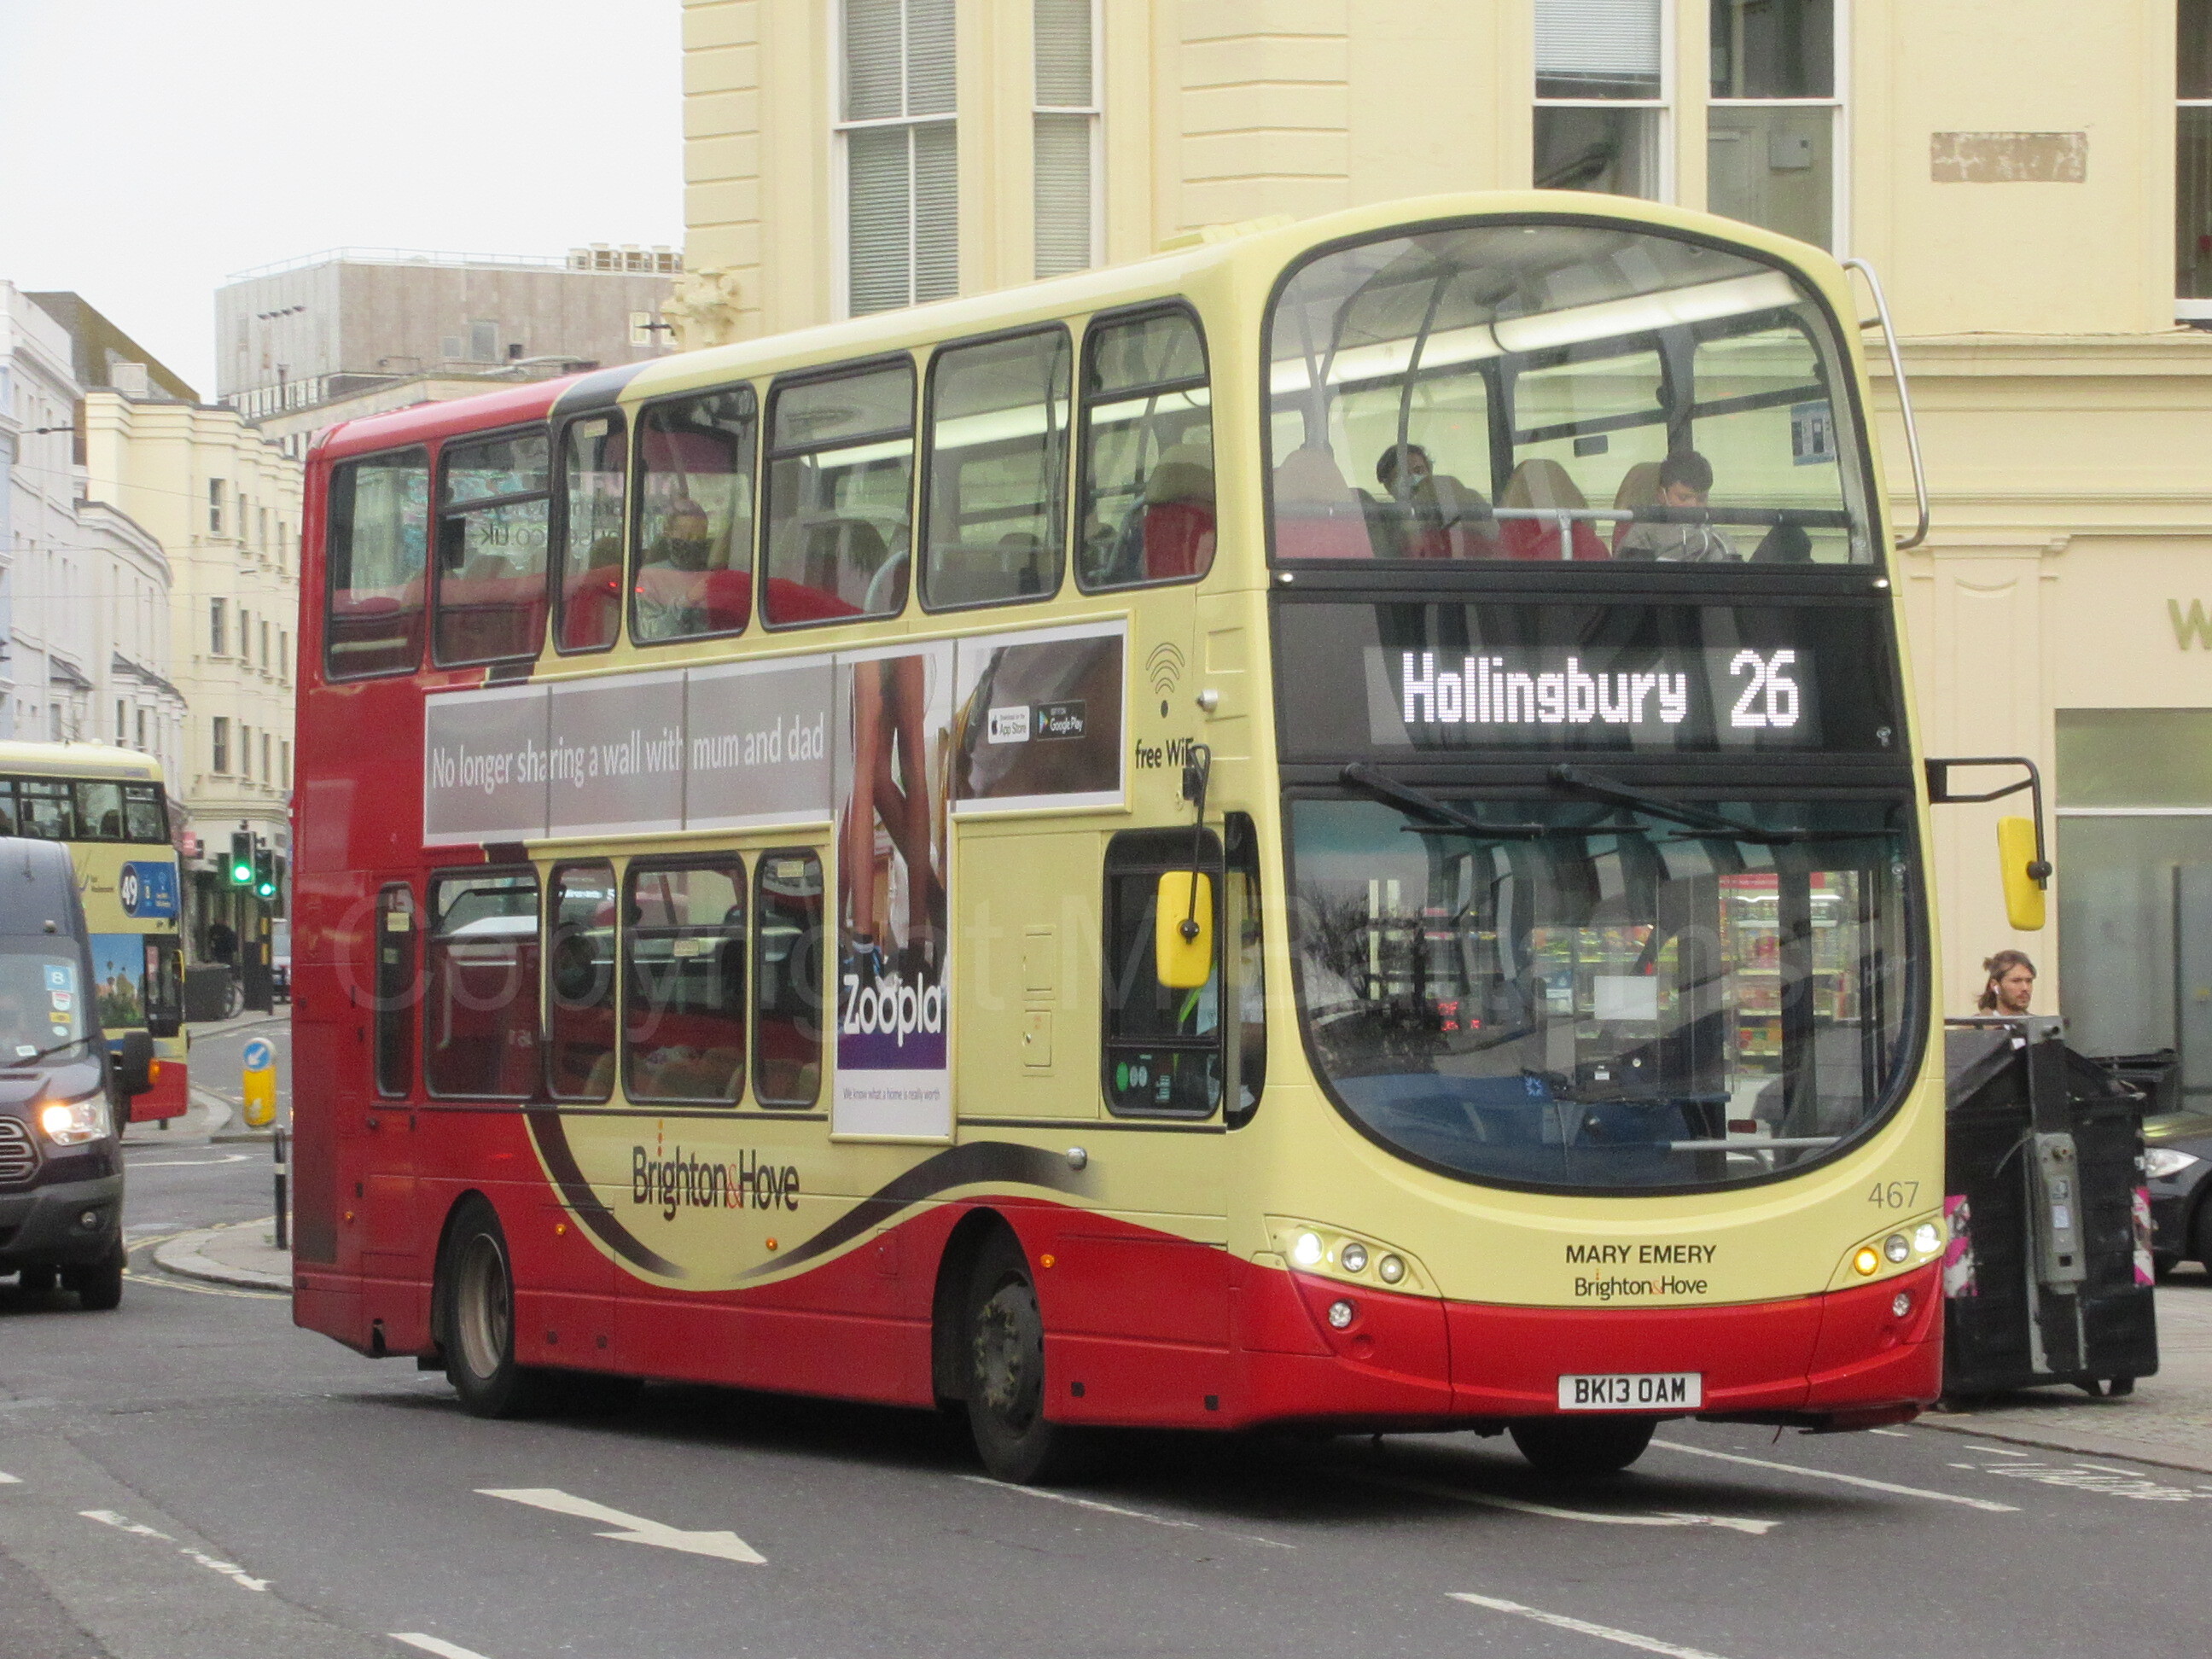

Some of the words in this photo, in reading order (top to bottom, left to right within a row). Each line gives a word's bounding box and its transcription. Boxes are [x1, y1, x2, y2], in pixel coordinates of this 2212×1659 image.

[1403, 652, 1686, 724] Hollingbury
[1730, 649, 1799, 727] 26
[999, 723, 1011, 736] App
[1012, 722, 1026, 734] Store
[1050, 718, 1070, 734] Google
[1071, 716, 1083, 732] Play
[433, 747, 454, 788] No
[459, 744, 513, 795] longer
[517, 736, 585, 789] sharing
[589, 746, 597, 777] a
[602, 729, 641, 776] wall
[646, 725, 684, 773] with
[693, 734, 739, 770] mum
[744, 716, 781, 765] and
[788, 712, 824, 761] dad
[1135, 738, 1162, 769] free
[1166, 736, 1195, 767] WiF
[122, 876, 138, 906] 49
[843, 971, 941, 1048] Zoopla
[843, 1087, 853, 1099] We
[853, 1087, 868, 1099] know
[869, 1087, 882, 1099] what
[888, 1087, 902, 1099] home
[1867, 1181, 1919, 1208] 467
[1565, 1244, 1632, 1264] MARY
[1639, 1244, 1717, 1264] EMERY
[1575, 1377, 1630, 1404] BK13
[1638, 1377, 1685, 1403] OAM
